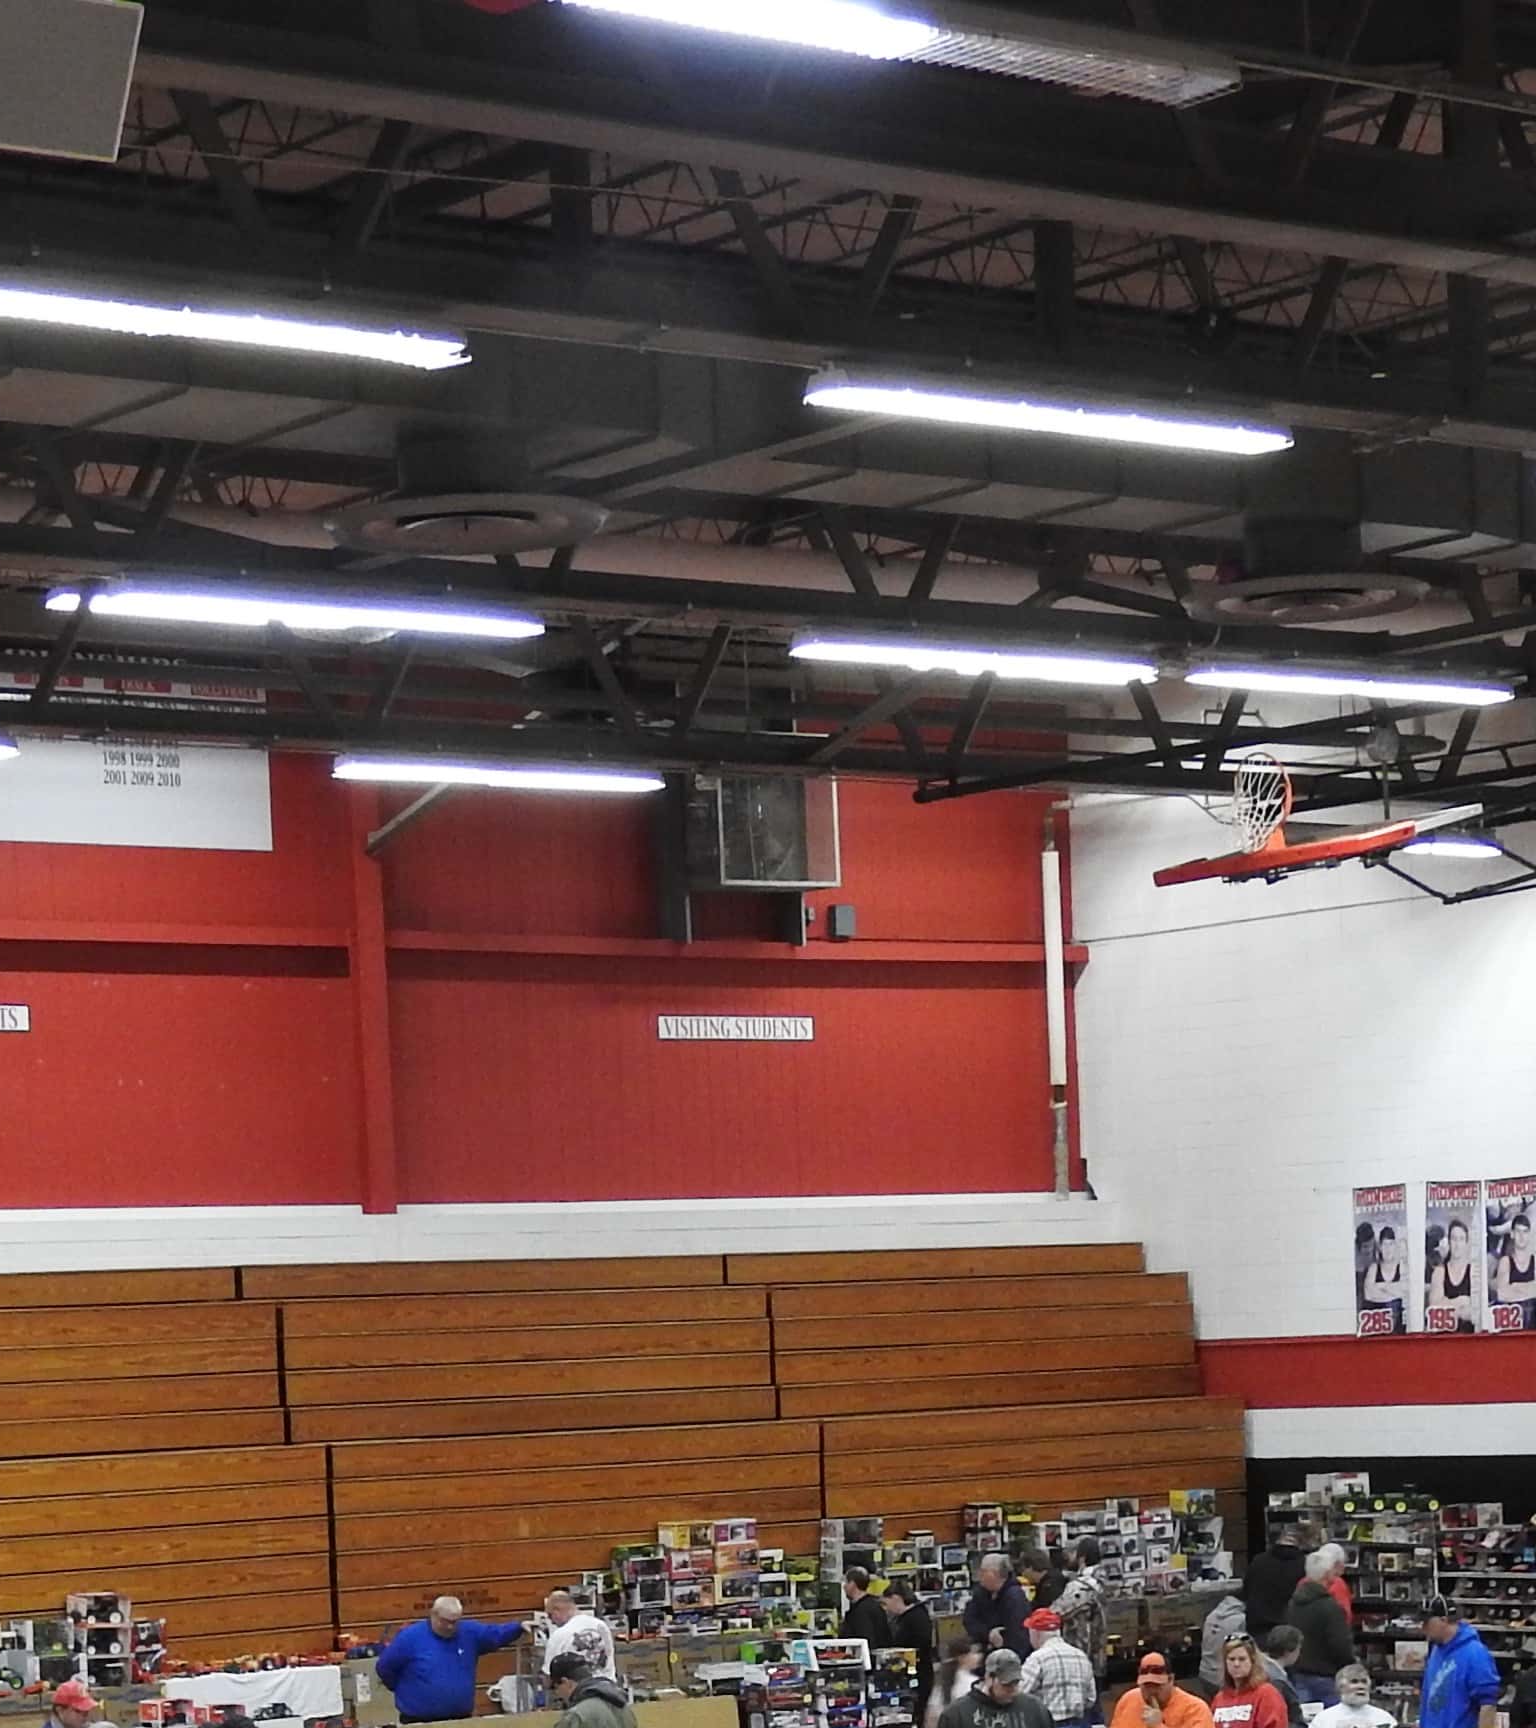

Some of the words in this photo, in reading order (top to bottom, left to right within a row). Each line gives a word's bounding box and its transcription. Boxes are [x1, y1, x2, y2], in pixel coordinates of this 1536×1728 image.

[102, 751, 126, 766] 1998
[156, 752, 180, 768] 2000
[104, 770, 127, 785] 2001
[131, 771, 154, 786] 2009
[157, 772, 181, 787] 2010
[664, 1017, 731, 1038] VISITING
[735, 1017, 809, 1040] STUDENTS
[1358, 1309, 1394, 1334] 285
[1426, 1306, 1457, 1331] 195
